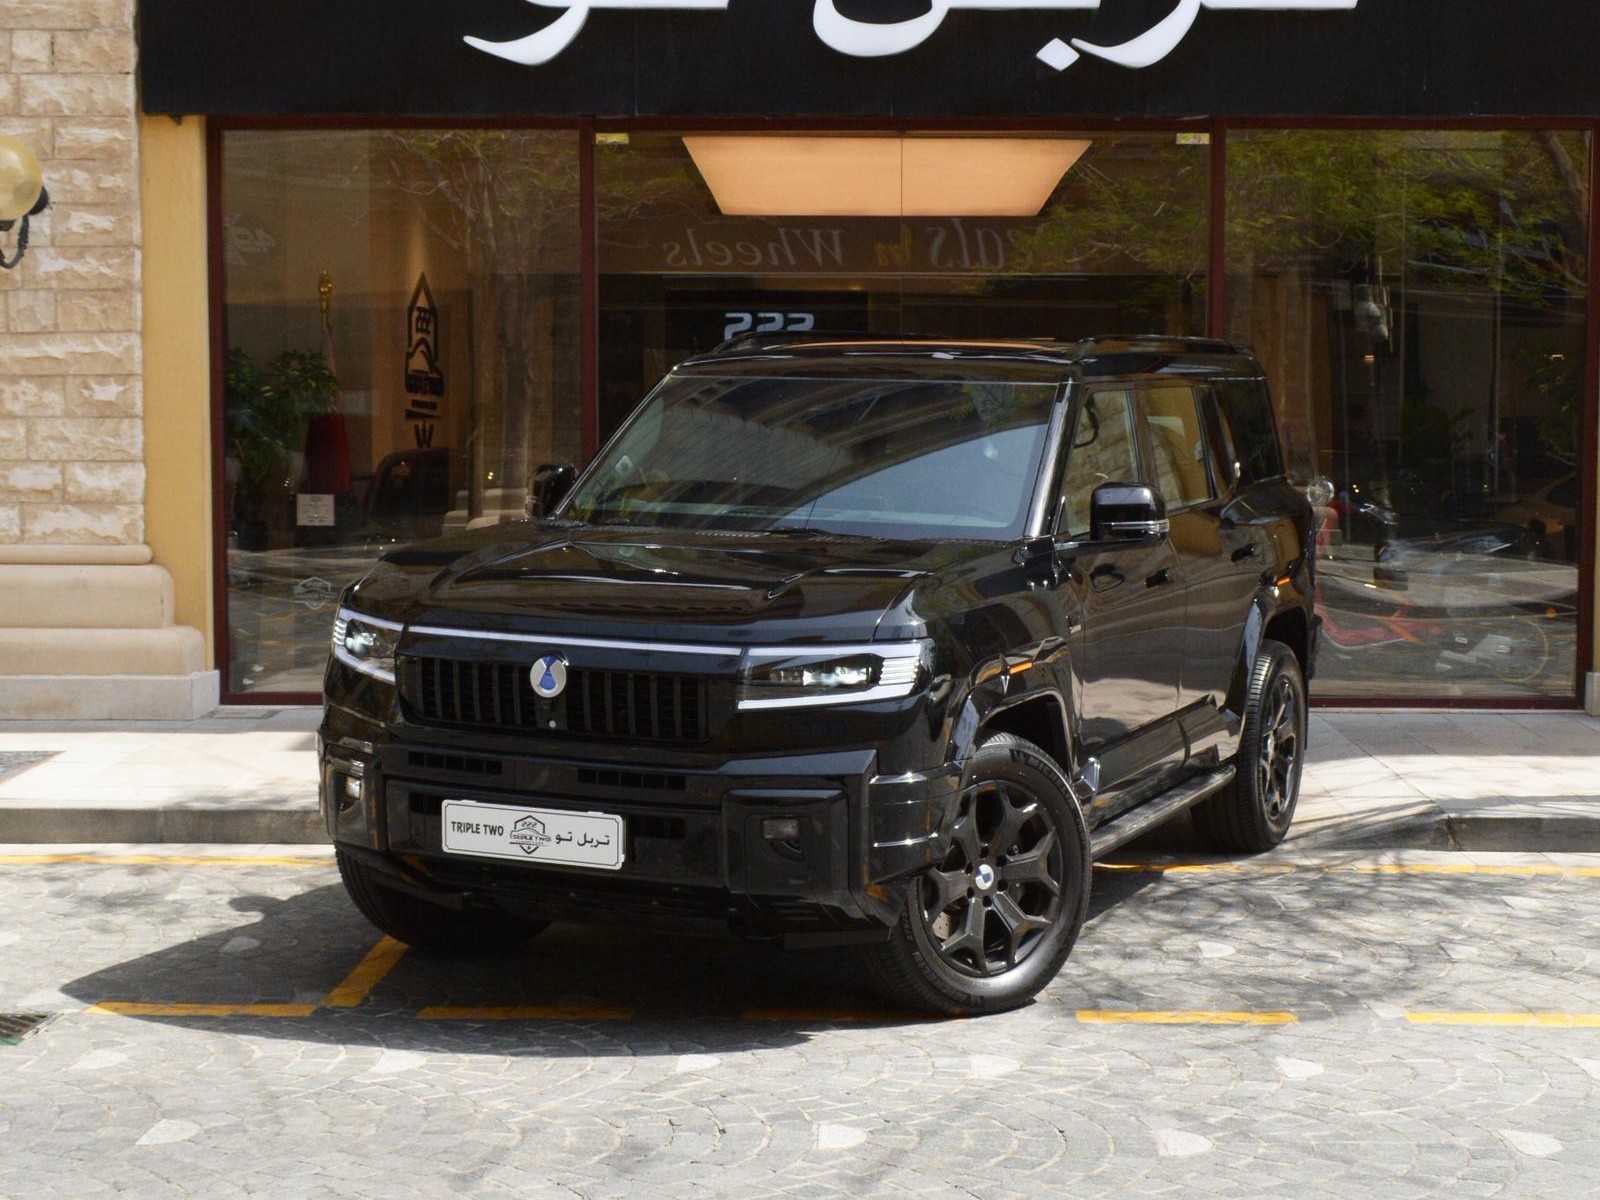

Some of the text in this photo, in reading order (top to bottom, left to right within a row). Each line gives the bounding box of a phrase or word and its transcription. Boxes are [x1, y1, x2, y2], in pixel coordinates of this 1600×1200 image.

[450, 821, 504, 837] TRIPLE TWO
[555, 831, 573, 845] تو
